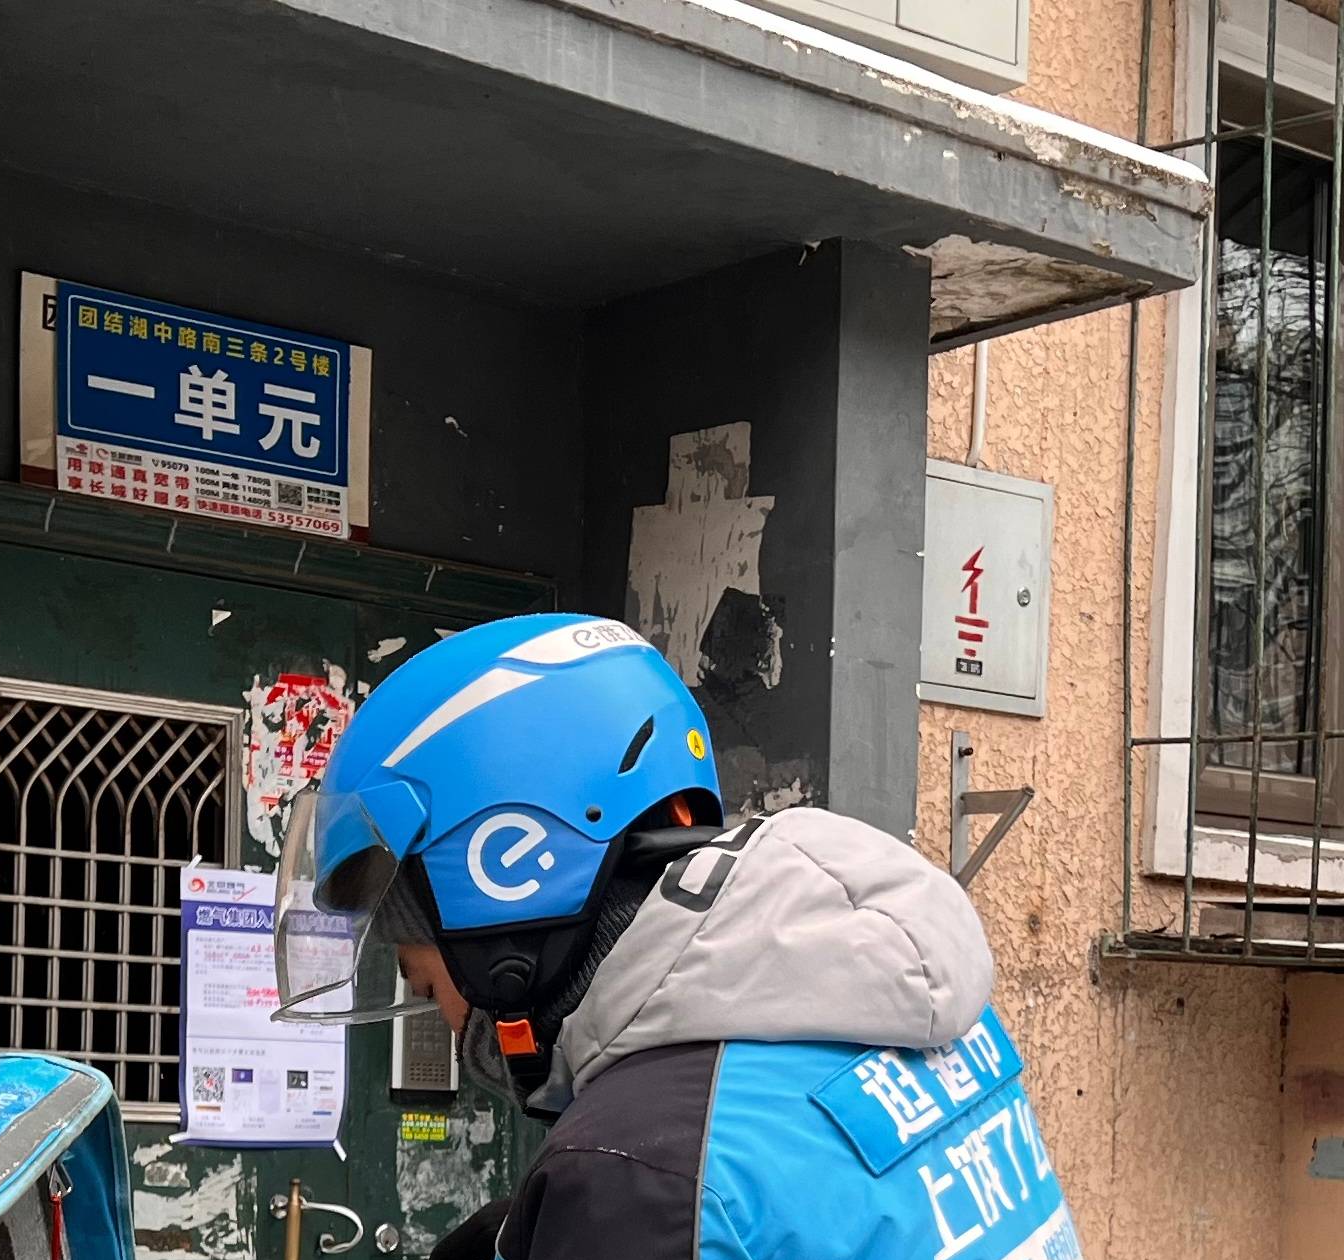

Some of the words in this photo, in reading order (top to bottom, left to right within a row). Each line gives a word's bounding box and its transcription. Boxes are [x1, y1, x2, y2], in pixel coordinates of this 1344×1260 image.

[78, 304, 332, 377] 团结湖中路南三条2号楼
[87, 363, 321, 459] 一单元
[268, 512, 340, 532] 53557069
